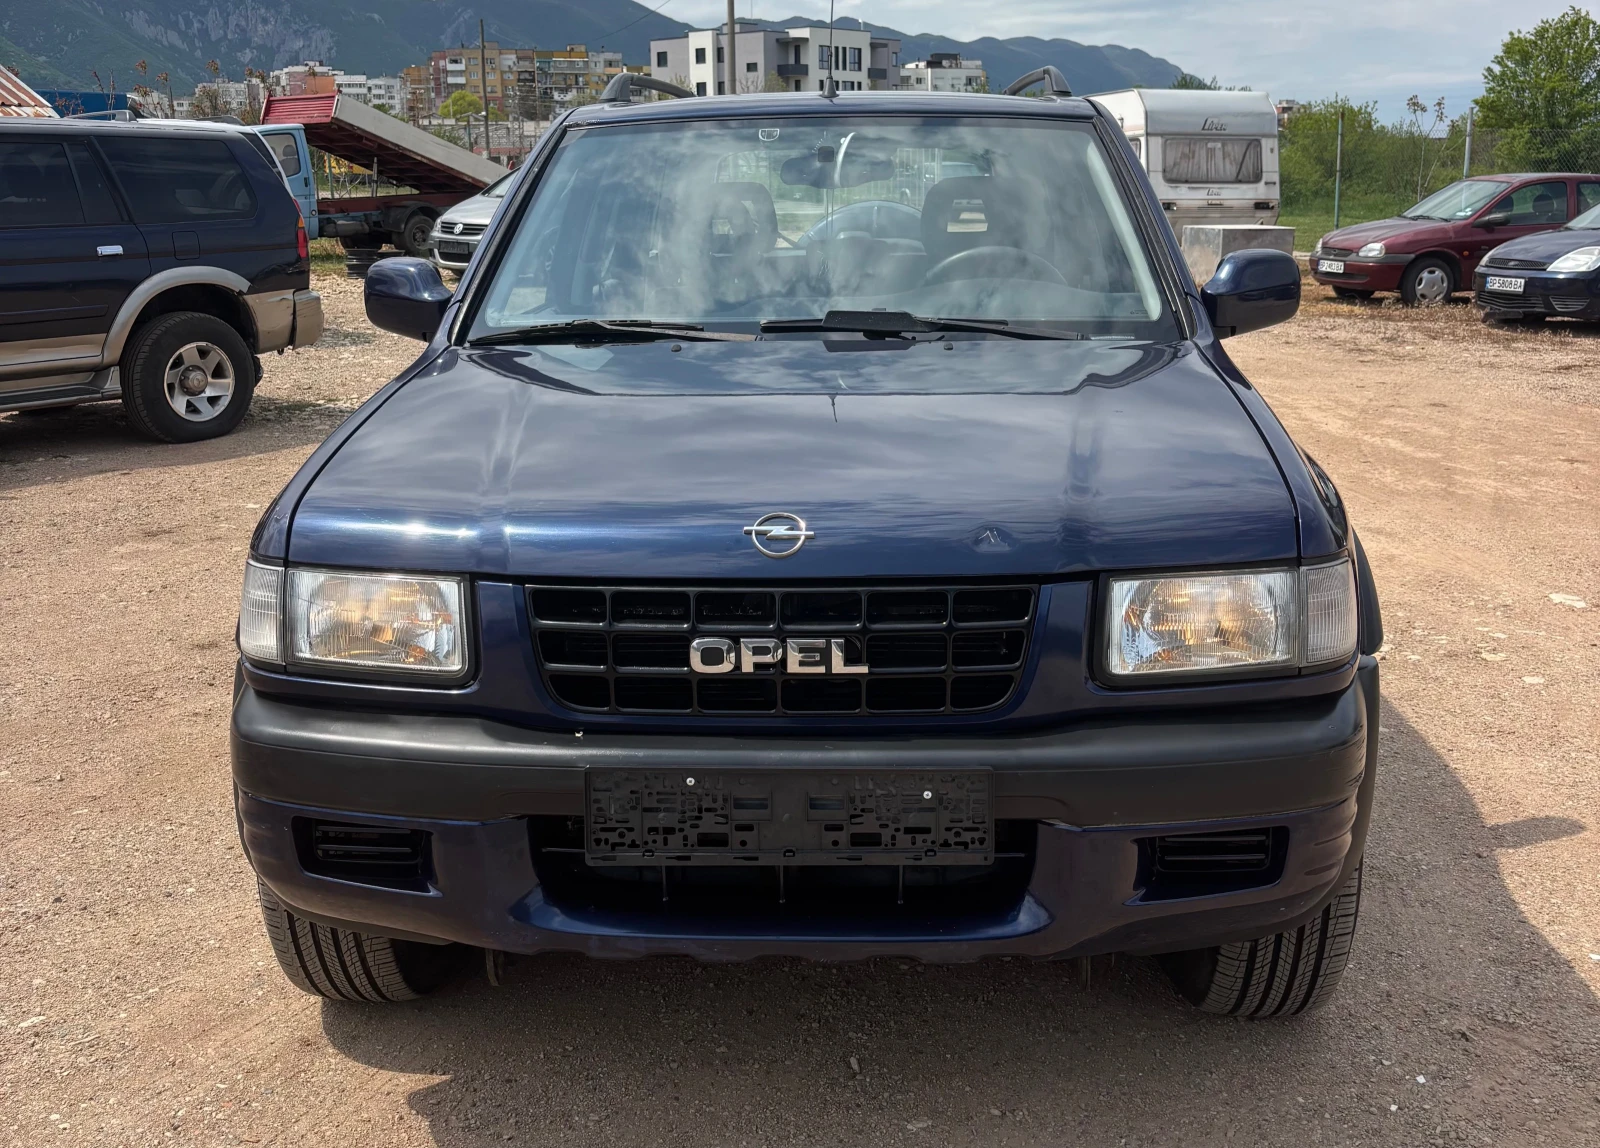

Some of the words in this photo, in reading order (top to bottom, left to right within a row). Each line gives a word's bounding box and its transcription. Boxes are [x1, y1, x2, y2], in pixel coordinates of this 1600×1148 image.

[1489, 277, 1497, 287] BP
[1513, 280, 1522, 290] BA
[689, 636, 870, 674] OPEL
